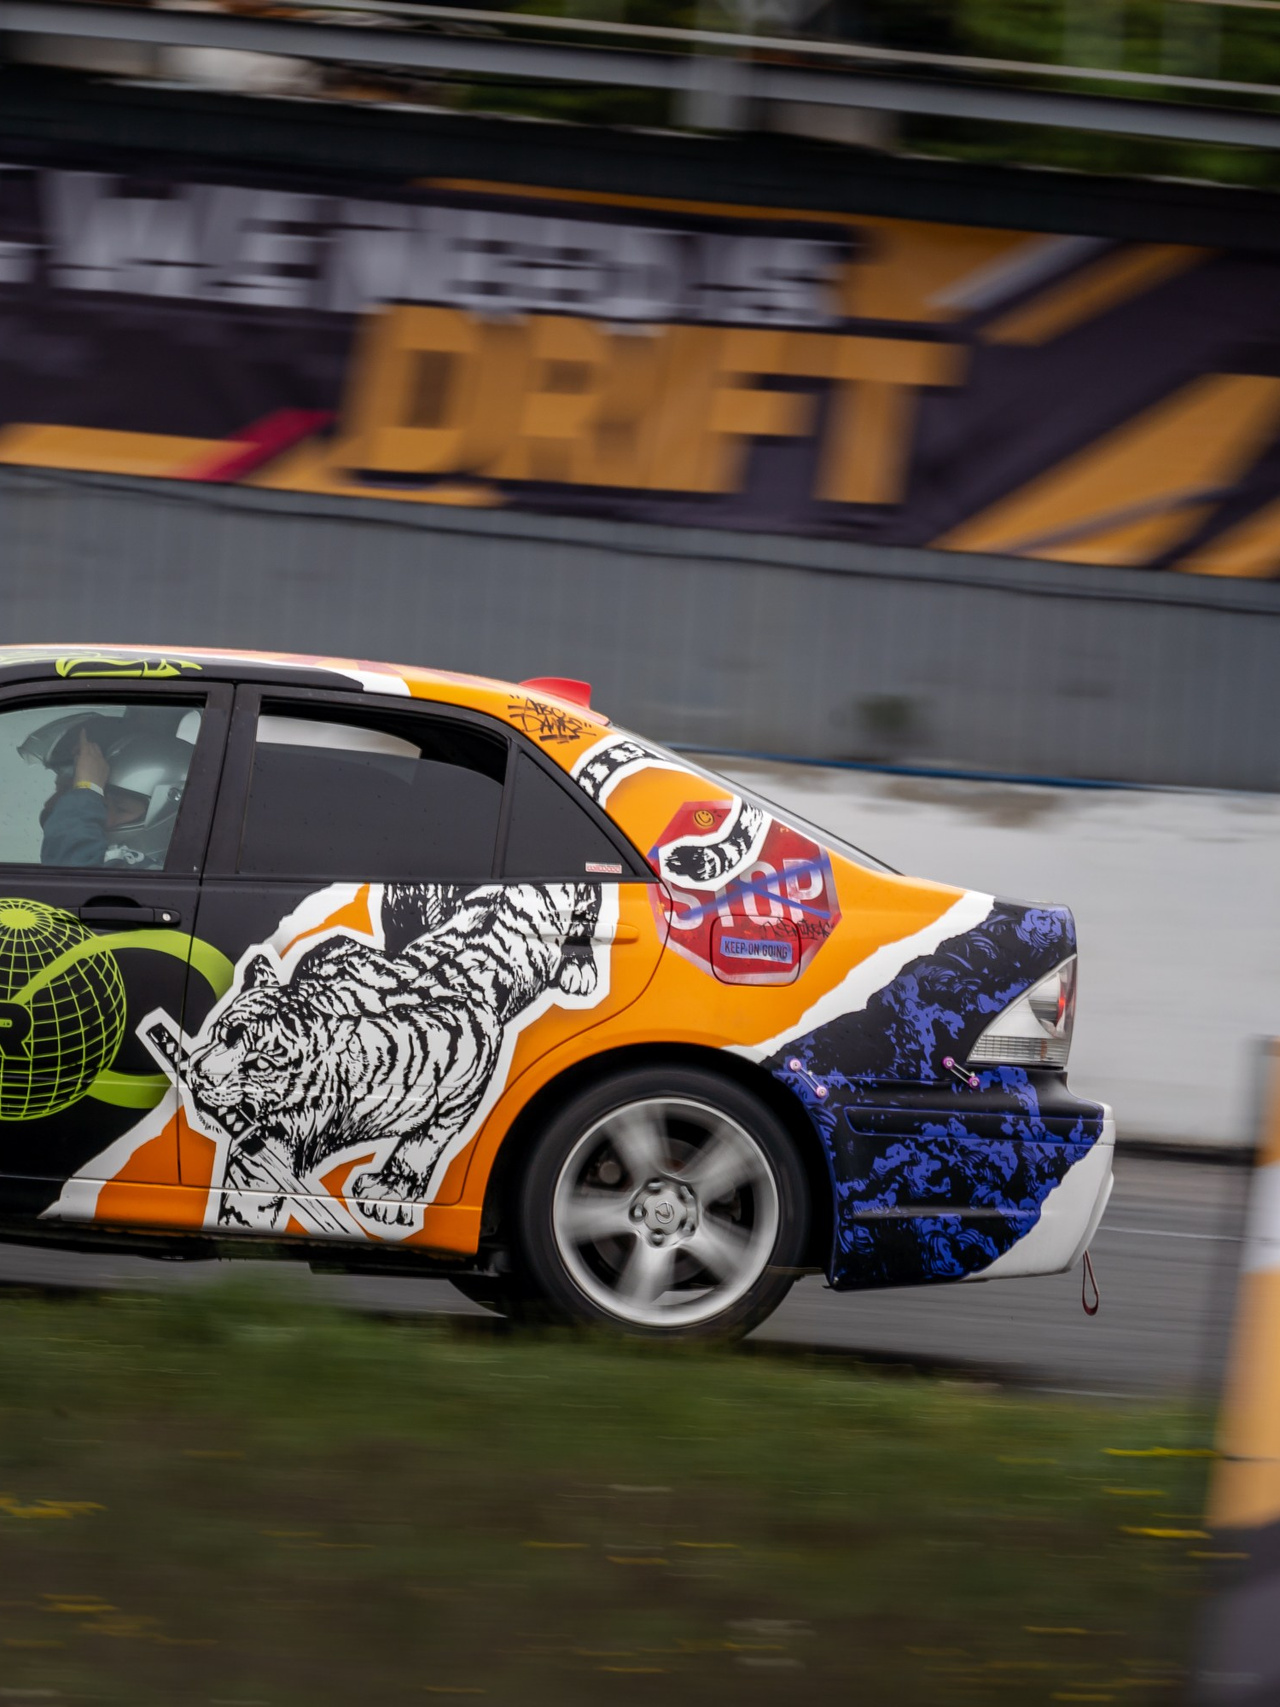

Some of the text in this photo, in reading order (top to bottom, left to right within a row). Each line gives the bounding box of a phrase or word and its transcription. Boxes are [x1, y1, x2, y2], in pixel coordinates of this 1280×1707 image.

[50, 168, 326, 309] WE
[342, 302, 966, 504] DRIFT
[724, 941, 788, 959] KEEP ON GOING
